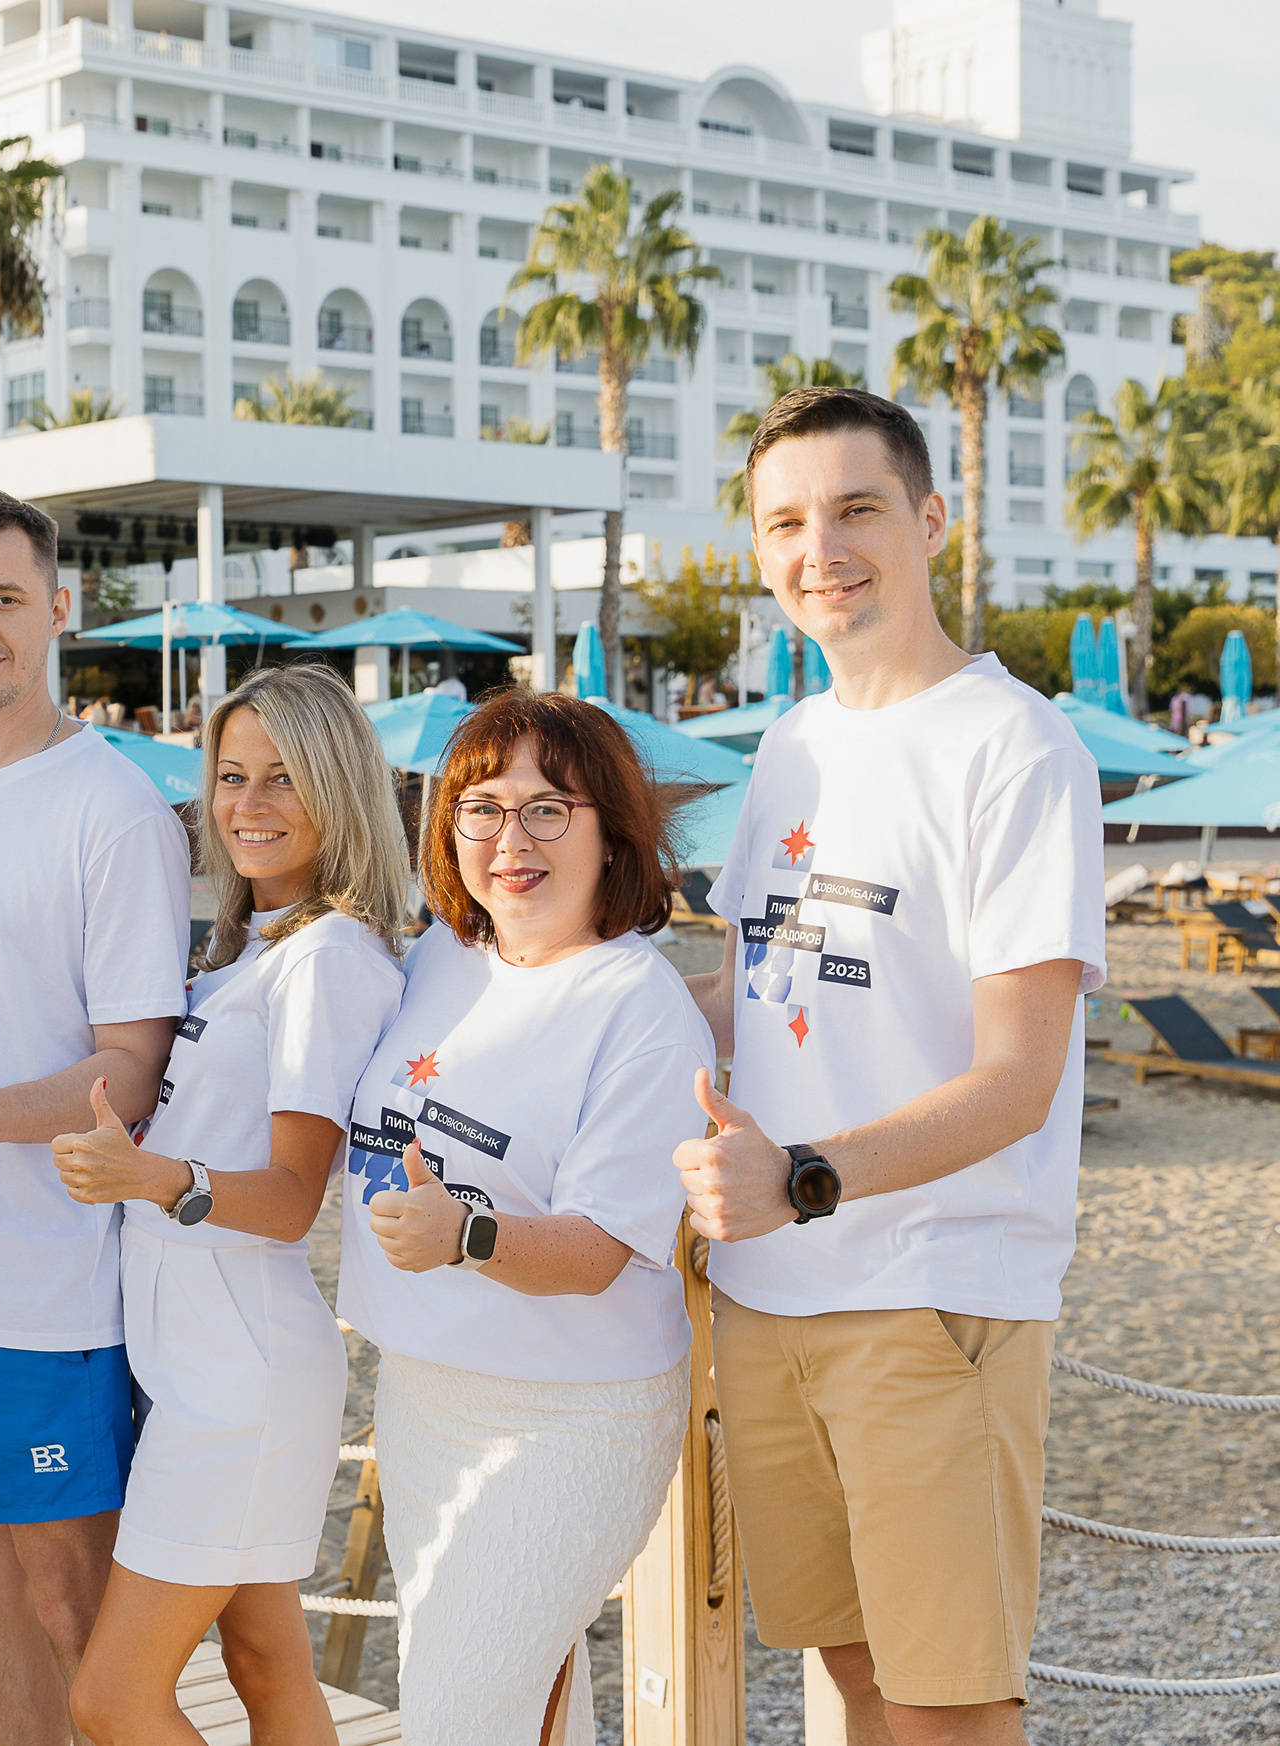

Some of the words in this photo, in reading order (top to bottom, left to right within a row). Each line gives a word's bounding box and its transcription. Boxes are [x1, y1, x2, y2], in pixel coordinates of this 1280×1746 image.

[817, 881, 888, 906] СОВКОМБАНК
[770, 902, 796, 916] ЛИГА
[748, 925, 822, 946] АМБАССАДОРОВ
[825, 961, 867, 980] 2025
[385, 1115, 414, 1134] ЛИГА
[437, 1112, 501, 1150] СОВКОМБАНК
[450, 1189, 488, 1205] 2025
[30, 1444, 69, 1468] BR
